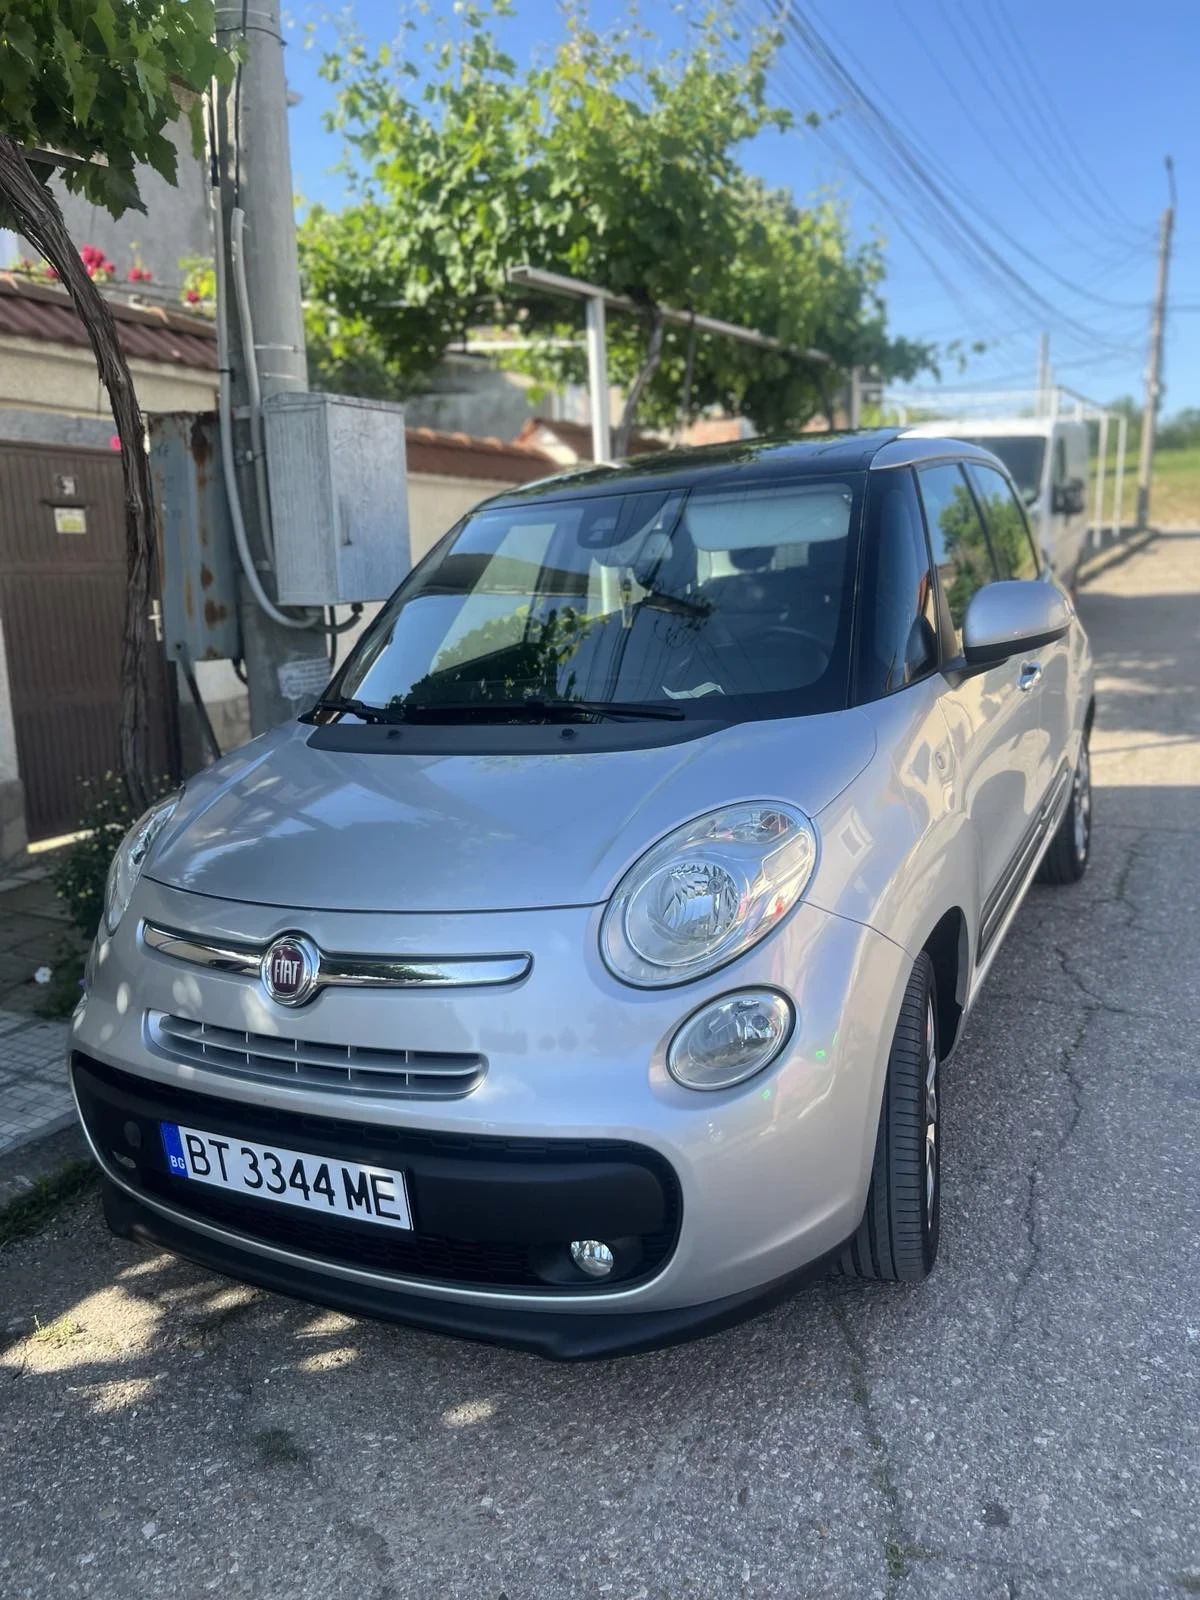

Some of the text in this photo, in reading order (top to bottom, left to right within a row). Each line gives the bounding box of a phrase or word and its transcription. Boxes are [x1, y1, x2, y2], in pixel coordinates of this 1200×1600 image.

[274, 959, 300, 985] FIAT
[170, 1155, 186, 1170] BG
[185, 1134, 401, 1220] BT 3344 ME
